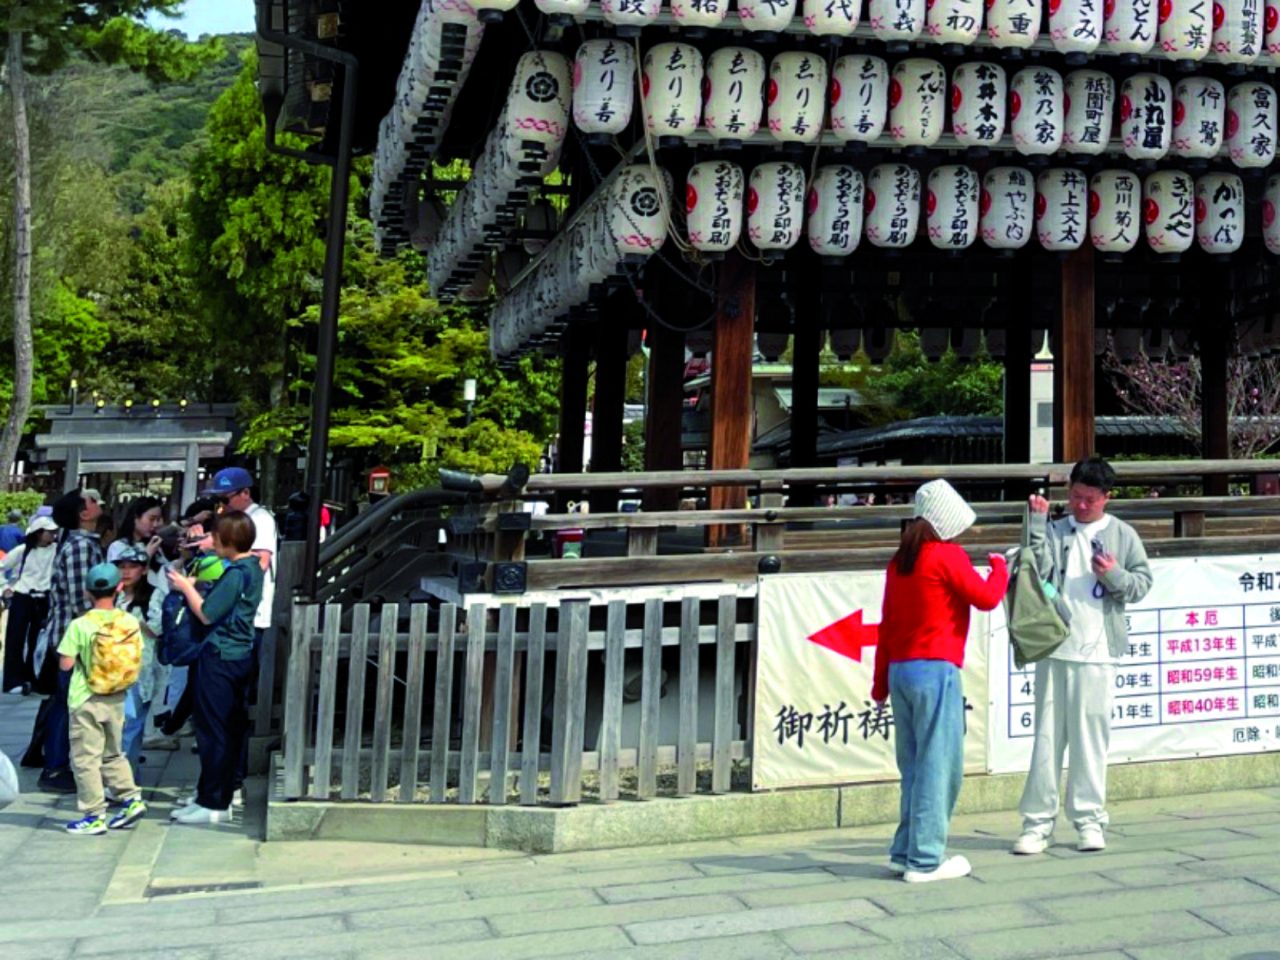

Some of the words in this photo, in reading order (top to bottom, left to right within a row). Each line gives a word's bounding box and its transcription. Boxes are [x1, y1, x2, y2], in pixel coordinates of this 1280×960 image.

[595, 40, 619, 123] ゑり善
[665, 46, 686, 129] ゑり善
[725, 50, 747, 133] ゑり善
[791, 57, 814, 136] ゑり善
[853, 58, 878, 133] ゑり善
[1251, 87, 1272, 157] 富久家
[708, 163, 732, 246] あおぞら印刷
[767, 164, 793, 246] あおぞら印刷
[828, 166, 851, 248] あおぞら印刷
[886, 165, 911, 244] あおぞら印刷
[948, 166, 969, 246] あおぞら印刷
[1058, 171, 1081, 244] 井上文太
[1120, 642, 1153, 659] 年生
[1166, 633, 1238, 655] 平成13年生
[1185, 610, 1219, 626] 本厄
[1167, 666, 1239, 685] 昭和59年生
[1167, 695, 1240, 716] 昭和40年生
